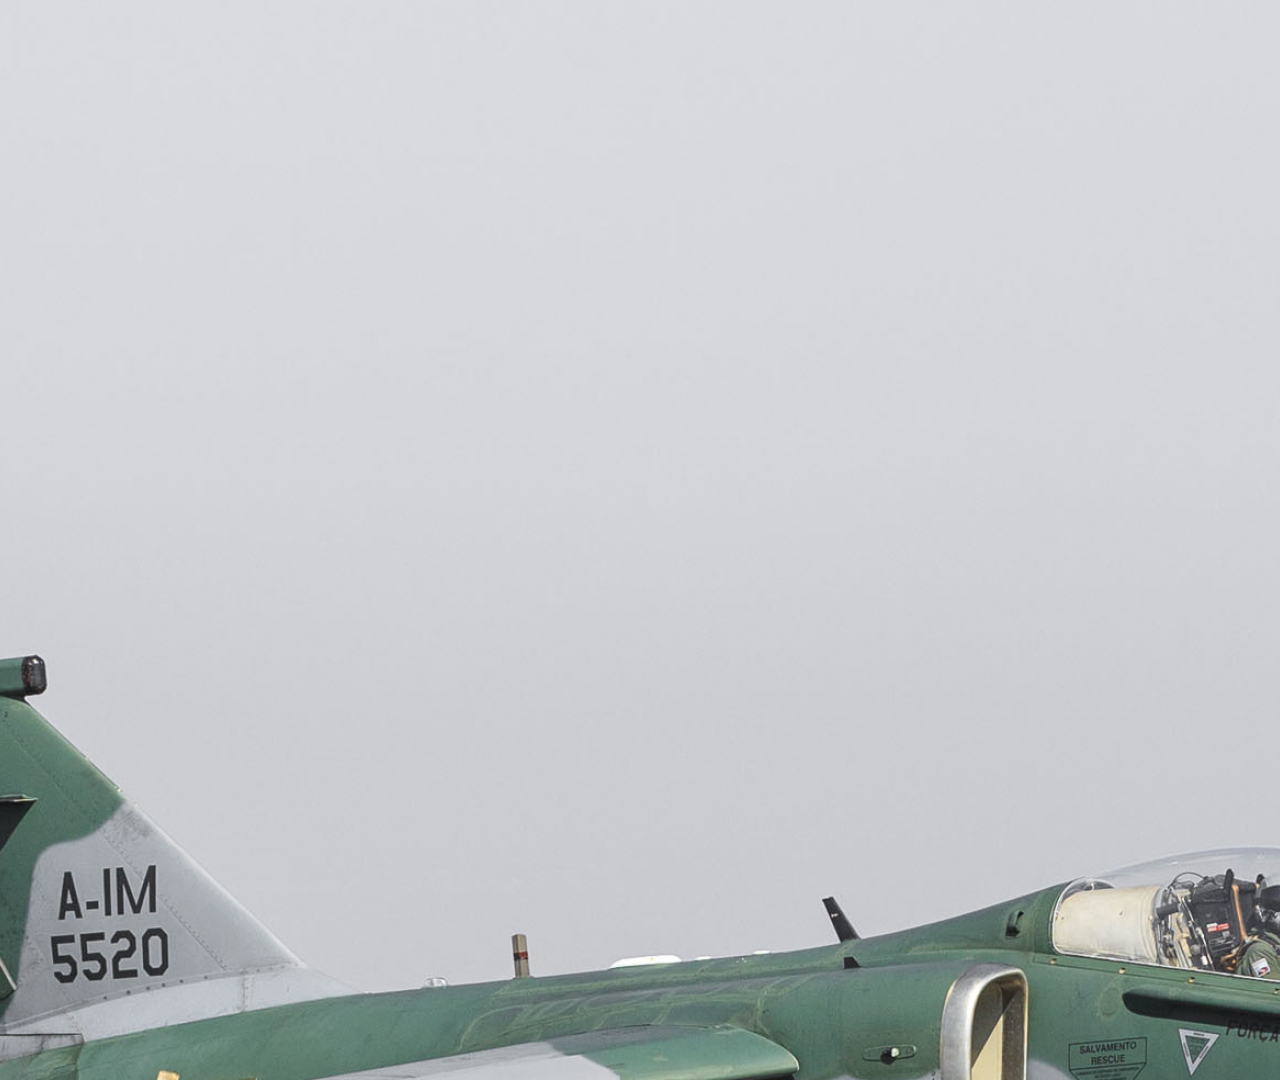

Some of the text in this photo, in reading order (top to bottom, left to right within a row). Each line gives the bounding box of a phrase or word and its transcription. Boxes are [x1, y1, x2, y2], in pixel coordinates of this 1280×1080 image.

[50, 927, 169, 984] 5520
[1079, 1041, 1137, 1055] SALVAMENTO
[1091, 1054, 1126, 1065] RESCUE
